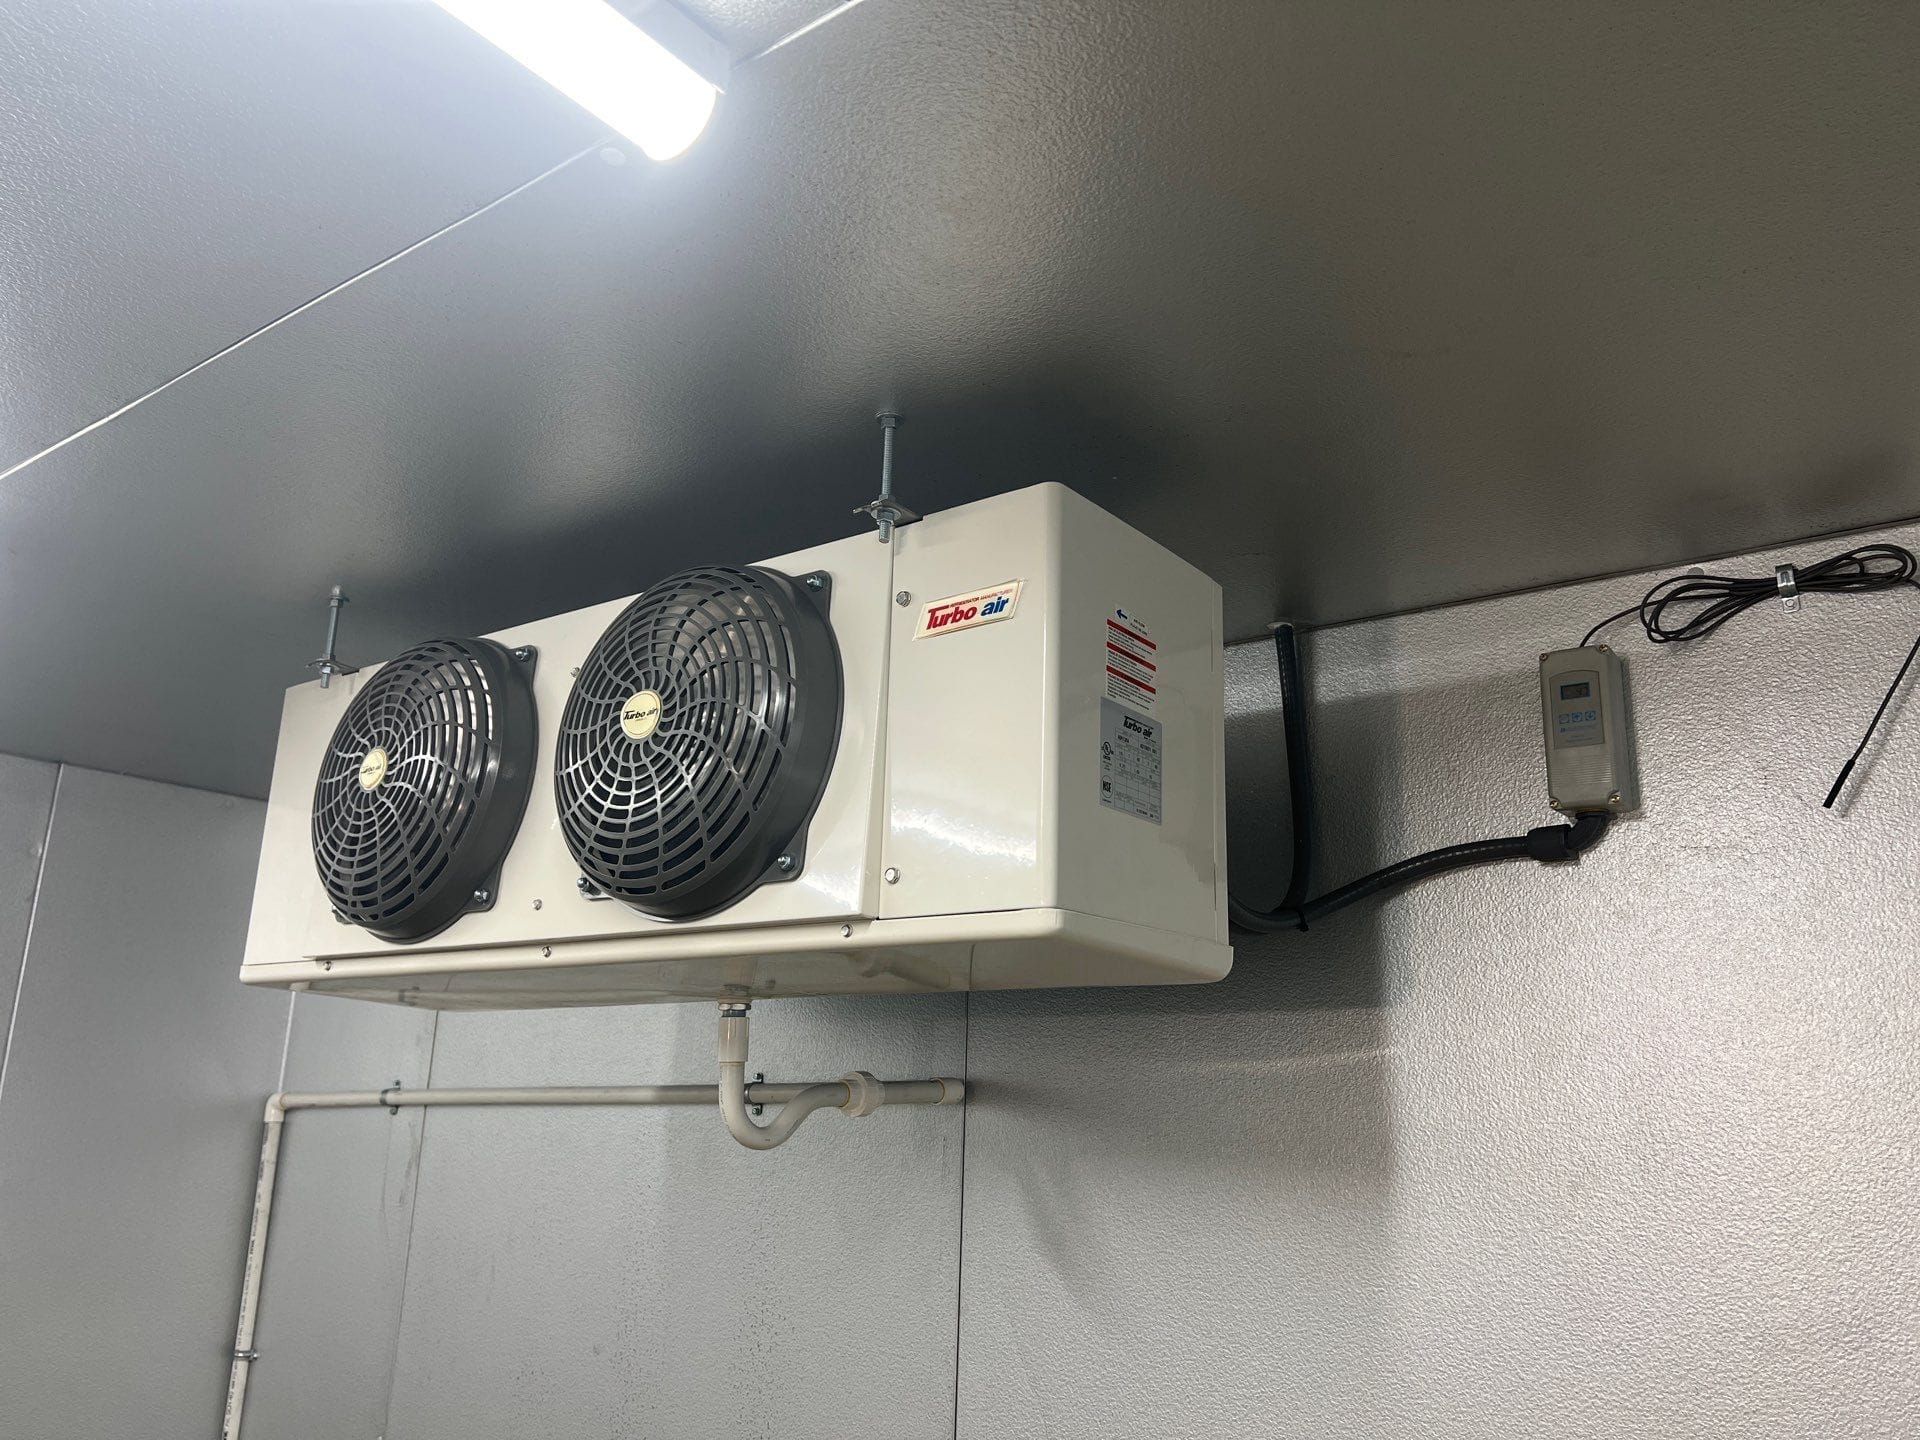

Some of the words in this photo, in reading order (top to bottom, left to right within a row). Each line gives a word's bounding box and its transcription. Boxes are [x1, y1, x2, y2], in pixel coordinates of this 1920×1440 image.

[926, 604, 978, 630] Turbo
[980, 596, 1010, 617] air
[624, 710, 646, 720] Turbo
[1123, 715, 1142, 734] Turbo
